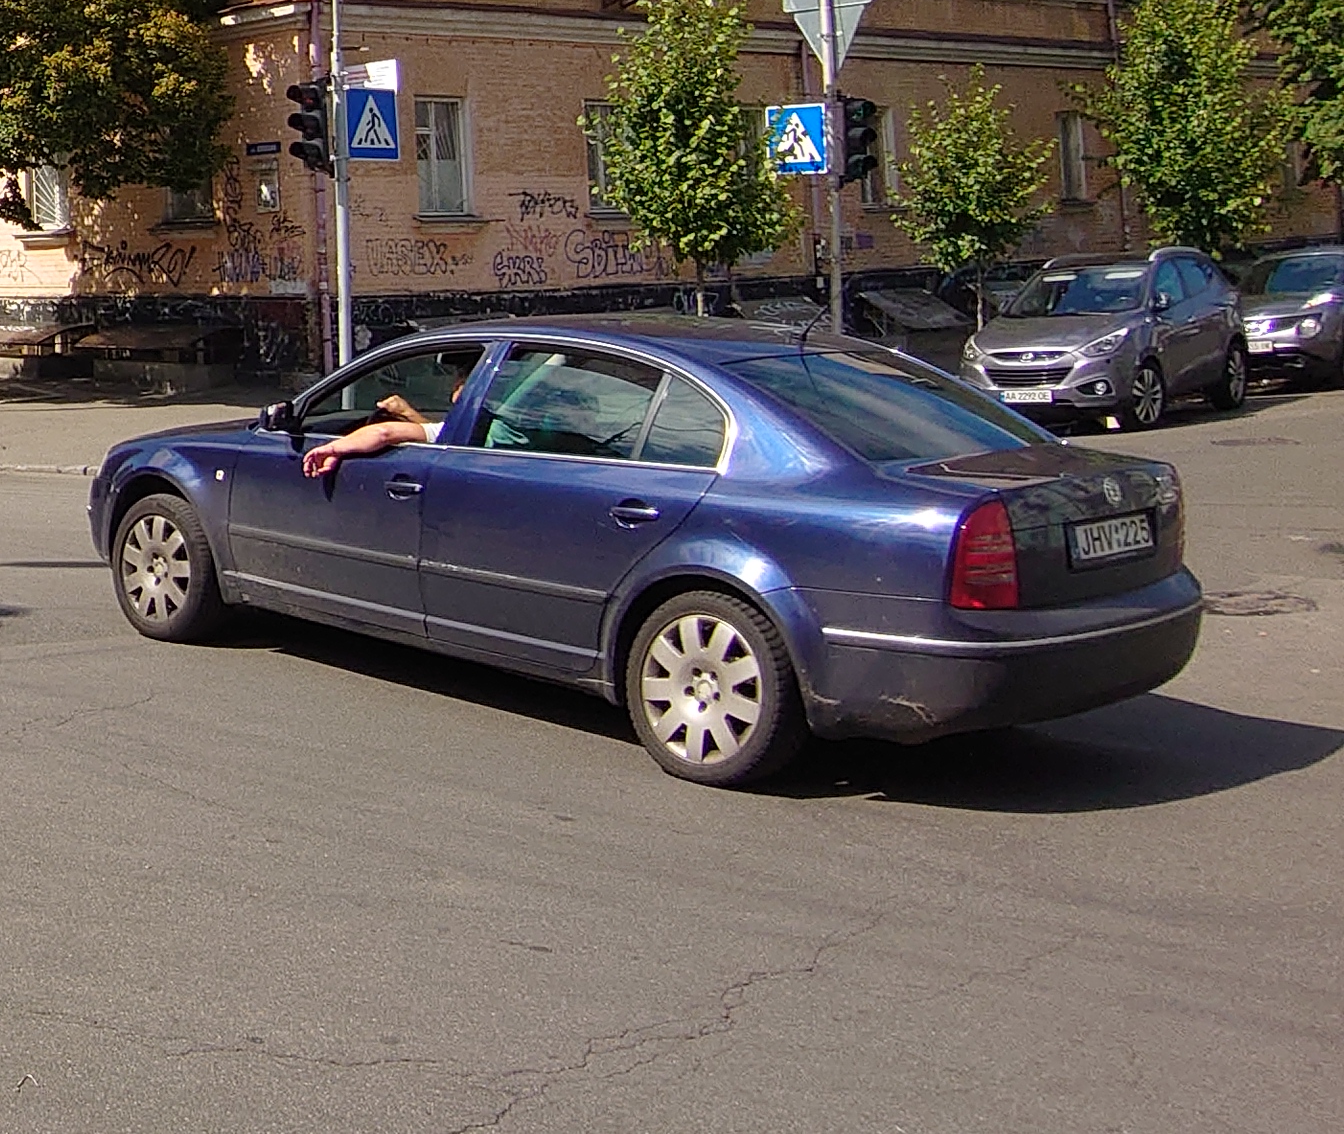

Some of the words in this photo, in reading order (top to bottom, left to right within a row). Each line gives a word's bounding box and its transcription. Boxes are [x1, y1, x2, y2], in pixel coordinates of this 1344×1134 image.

[1005, 392, 1017, 400] AA
[1082, 524, 1115, 556] JHV
[1120, 518, 1150, 547] 225
